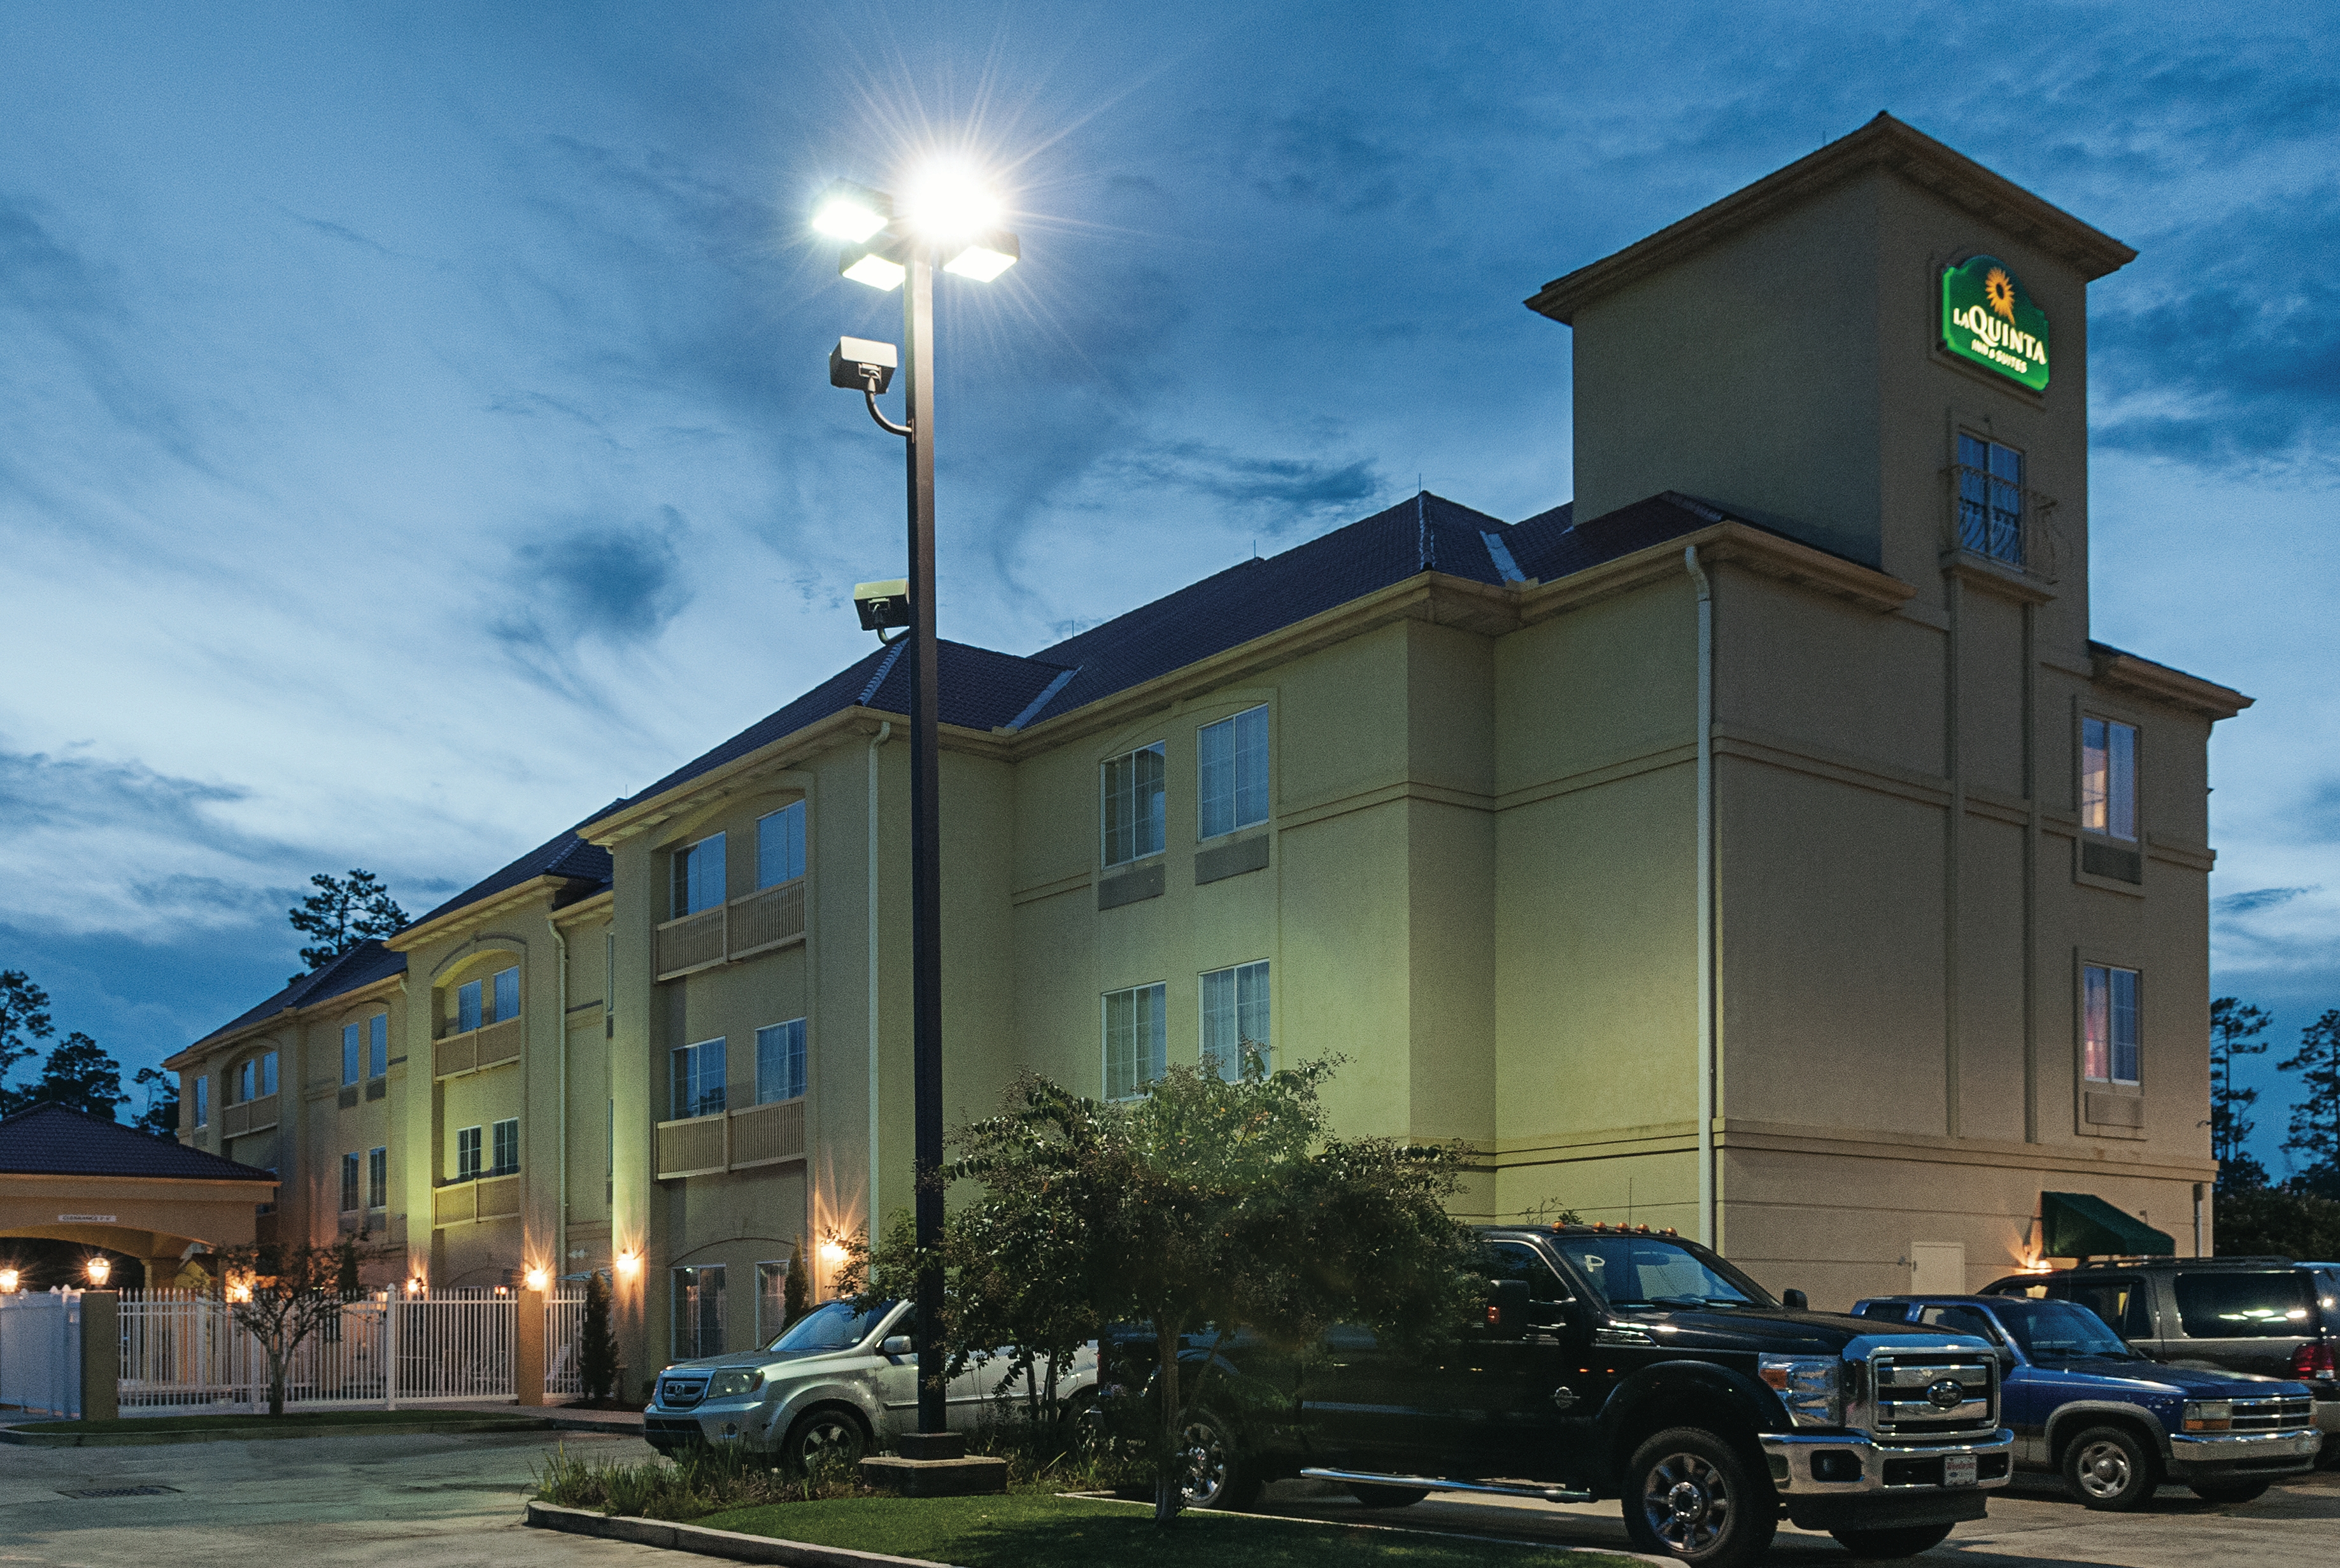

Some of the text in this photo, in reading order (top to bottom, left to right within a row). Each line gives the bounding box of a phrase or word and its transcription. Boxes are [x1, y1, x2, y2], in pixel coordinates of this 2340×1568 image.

[1953, 305, 2047, 365] LA QUINTA
[1971, 339, 2027, 374] INN & SUITES
